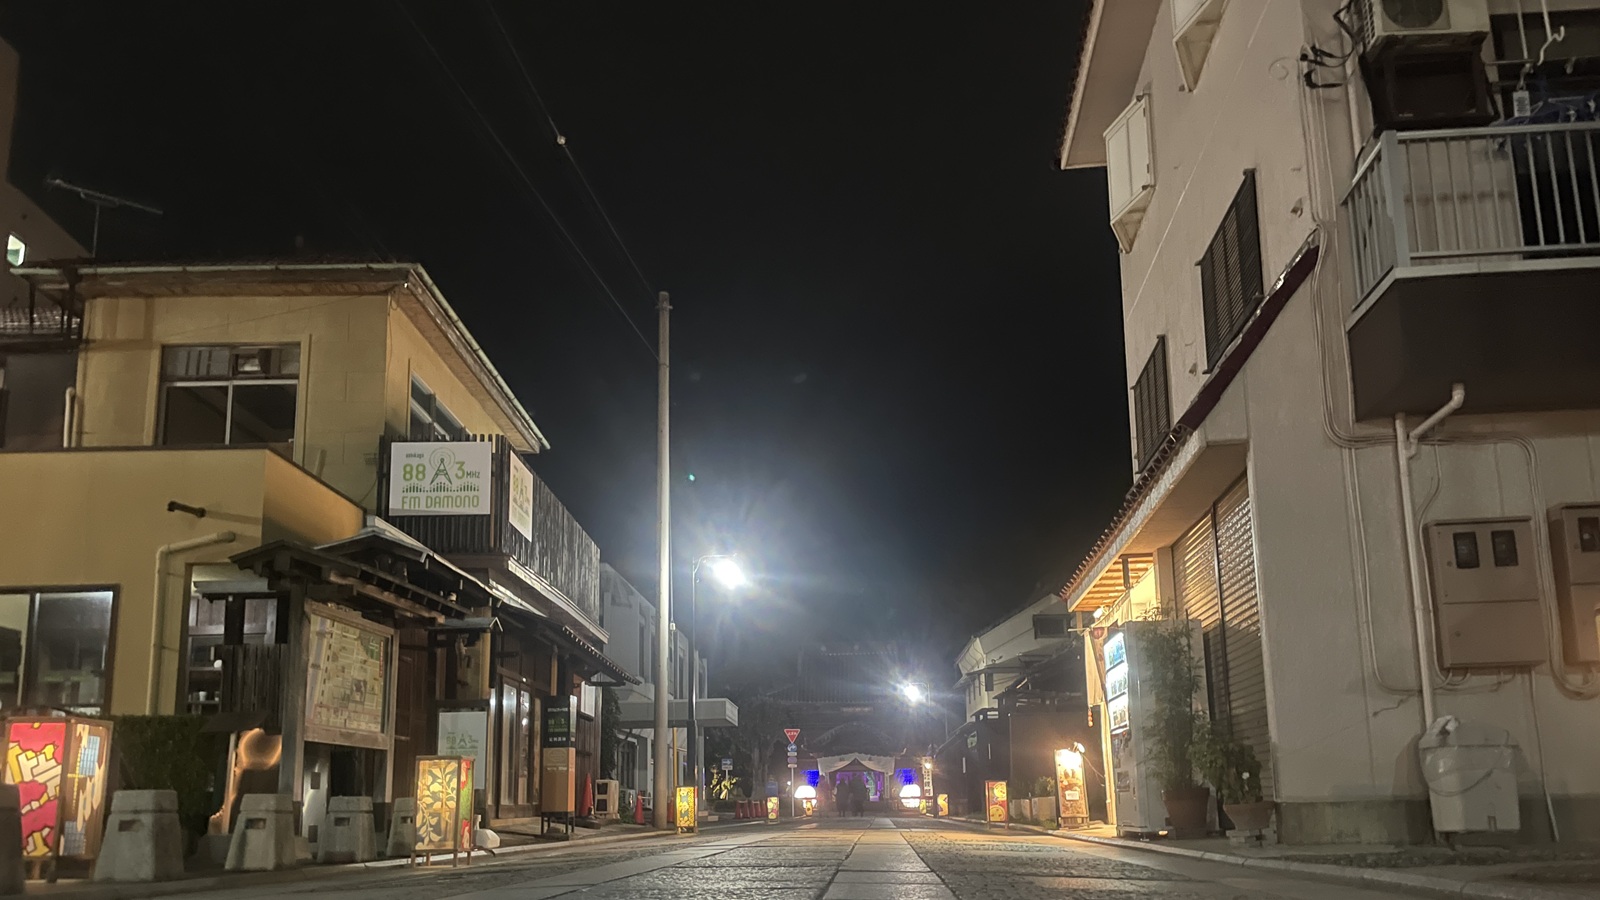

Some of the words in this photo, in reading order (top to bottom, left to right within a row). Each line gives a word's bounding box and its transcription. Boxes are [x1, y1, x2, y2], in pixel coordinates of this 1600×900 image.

[403, 463, 426, 481] 88
[455, 461, 465, 480] 3
[401, 496, 420, 510] FM
[425, 495, 479, 508] DAMONO
